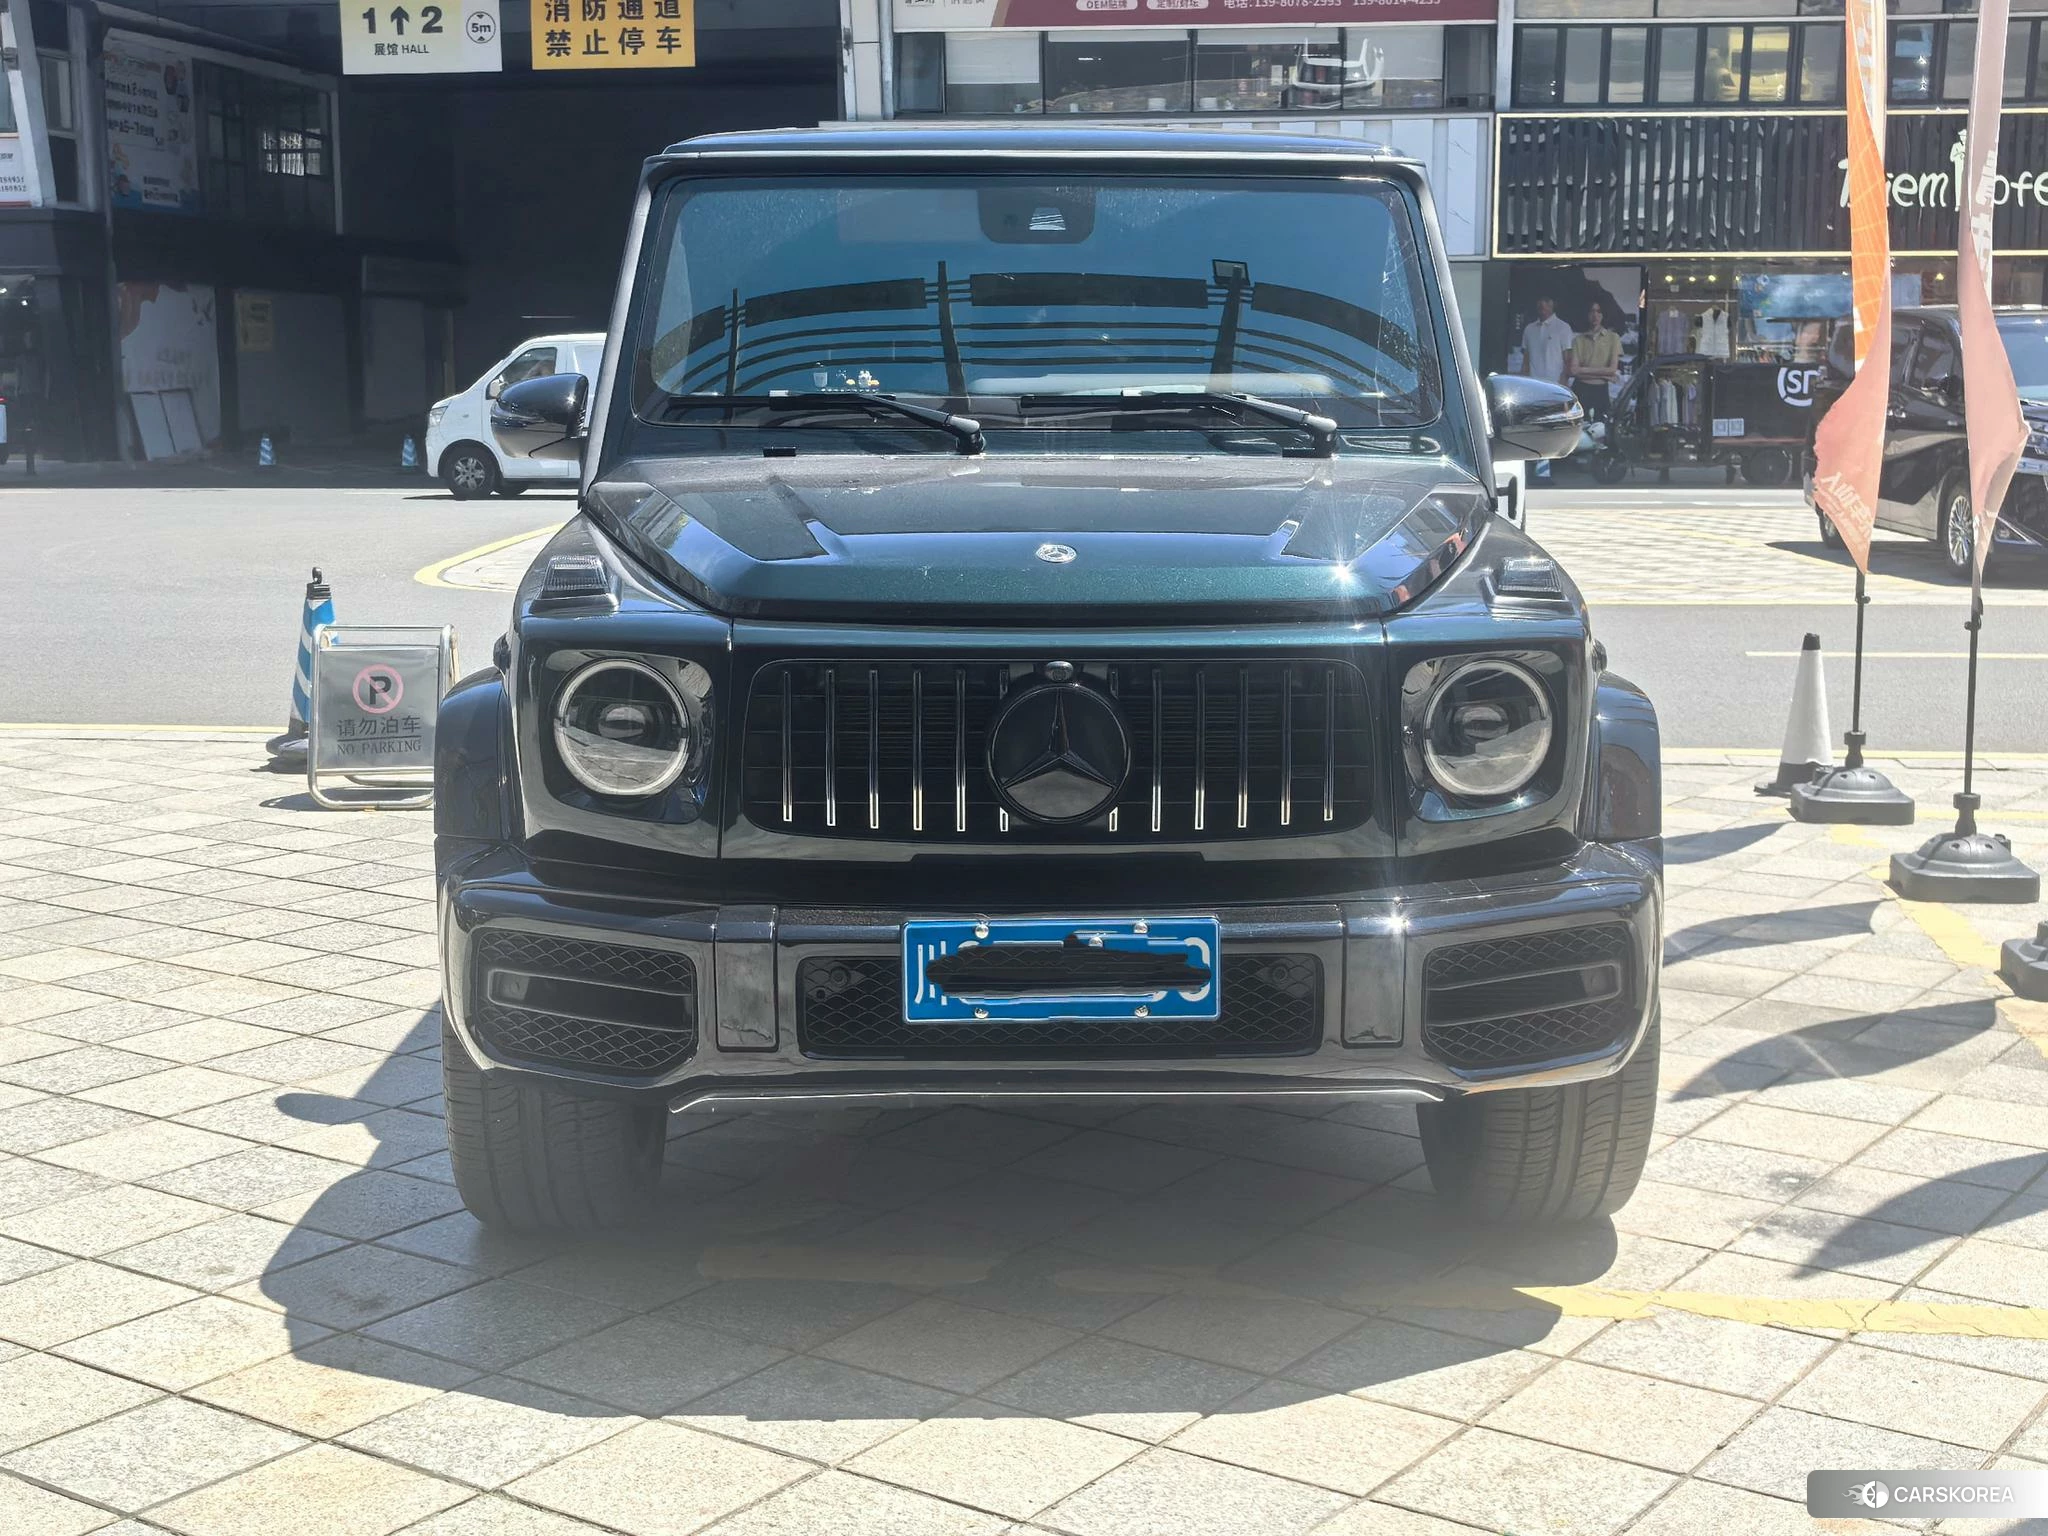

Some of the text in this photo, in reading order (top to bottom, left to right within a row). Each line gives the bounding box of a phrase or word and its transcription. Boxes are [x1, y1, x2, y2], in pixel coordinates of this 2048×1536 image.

[362, 5, 443, 34] 1 2
[544, 0, 681, 22] 消防通道
[471, 22, 491, 33] 5m
[374, 43, 429, 56] 展馆 HALL
[545, 26, 682, 57] 禁止停车
[336, 715, 422, 737] 请勿泊车
[337, 739, 422, 756] NO PARKING
